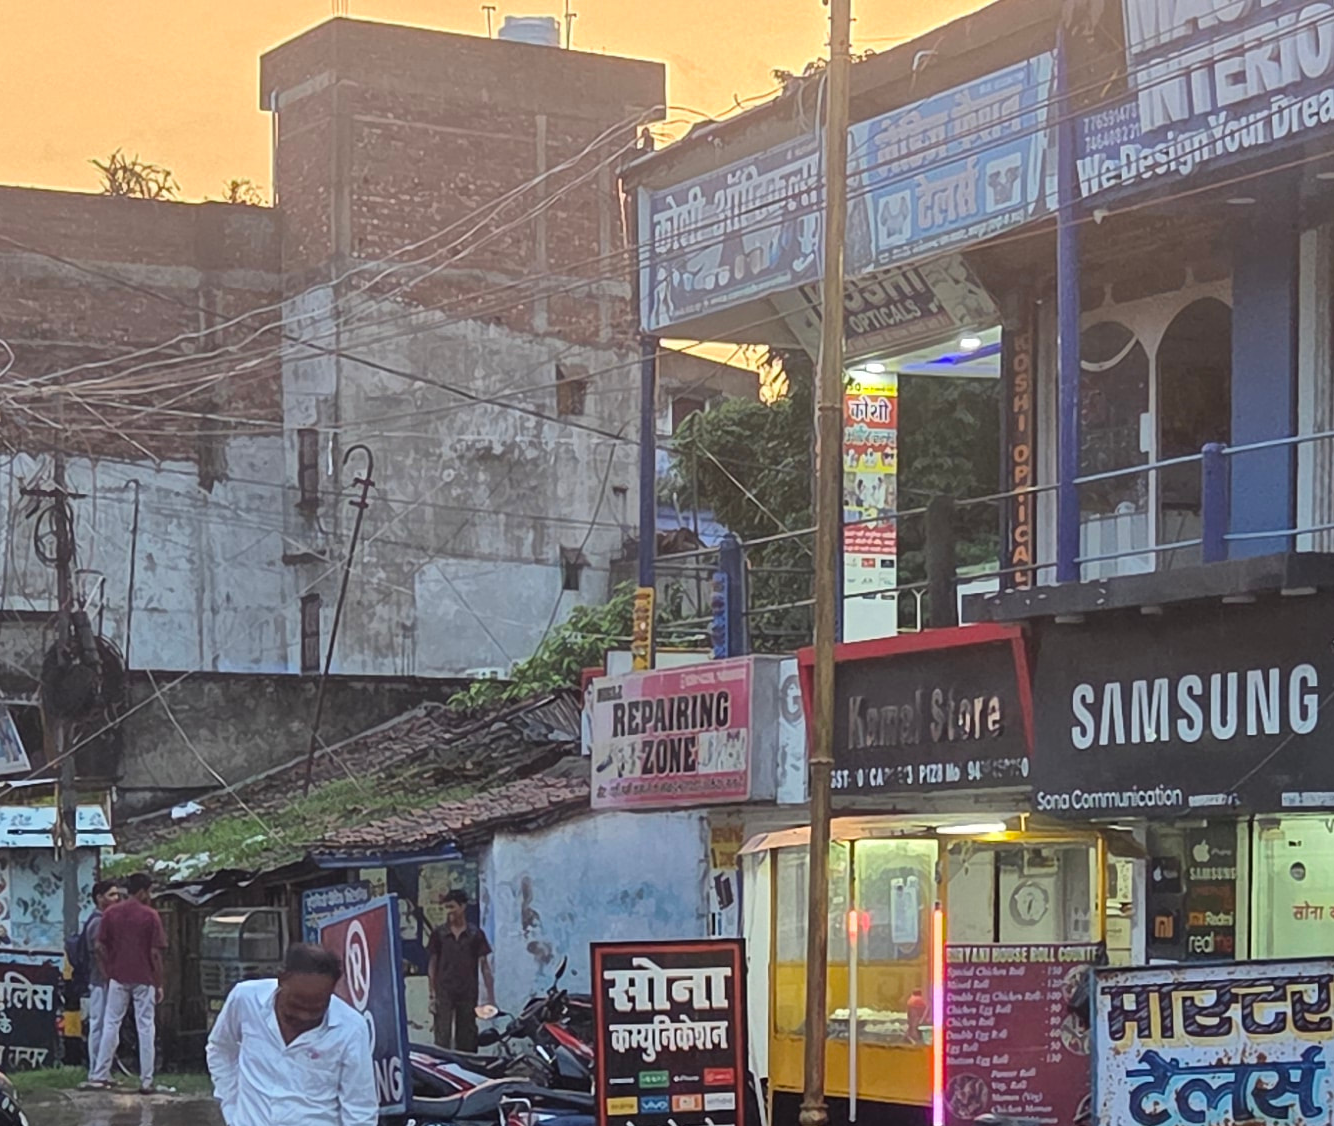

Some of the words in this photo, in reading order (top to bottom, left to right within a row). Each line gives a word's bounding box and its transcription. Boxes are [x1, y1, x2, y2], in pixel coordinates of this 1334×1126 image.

[1121, 126, 1216, 187] Design
[1208, 111, 1273, 154] Your
[848, 298, 922, 334] OPTICALS
[612, 690, 730, 737] REPAIRING
[929, 688, 1001, 742] Store
[1071, 664, 1318, 749] SAMSUNG
[641, 735, 697, 775] ZONE
[1037, 790, 1070, 810] Sona
[1072, 784, 1183, 809] Communication
[1293, 901, 1324, 920] सोना
[992, 947, 1028, 962] HOUSE
[1030, 947, 1055, 962] ROLL
[604, 957, 732, 1012] सोना
[608, 1014, 729, 1062] कम्युनिकेशन
